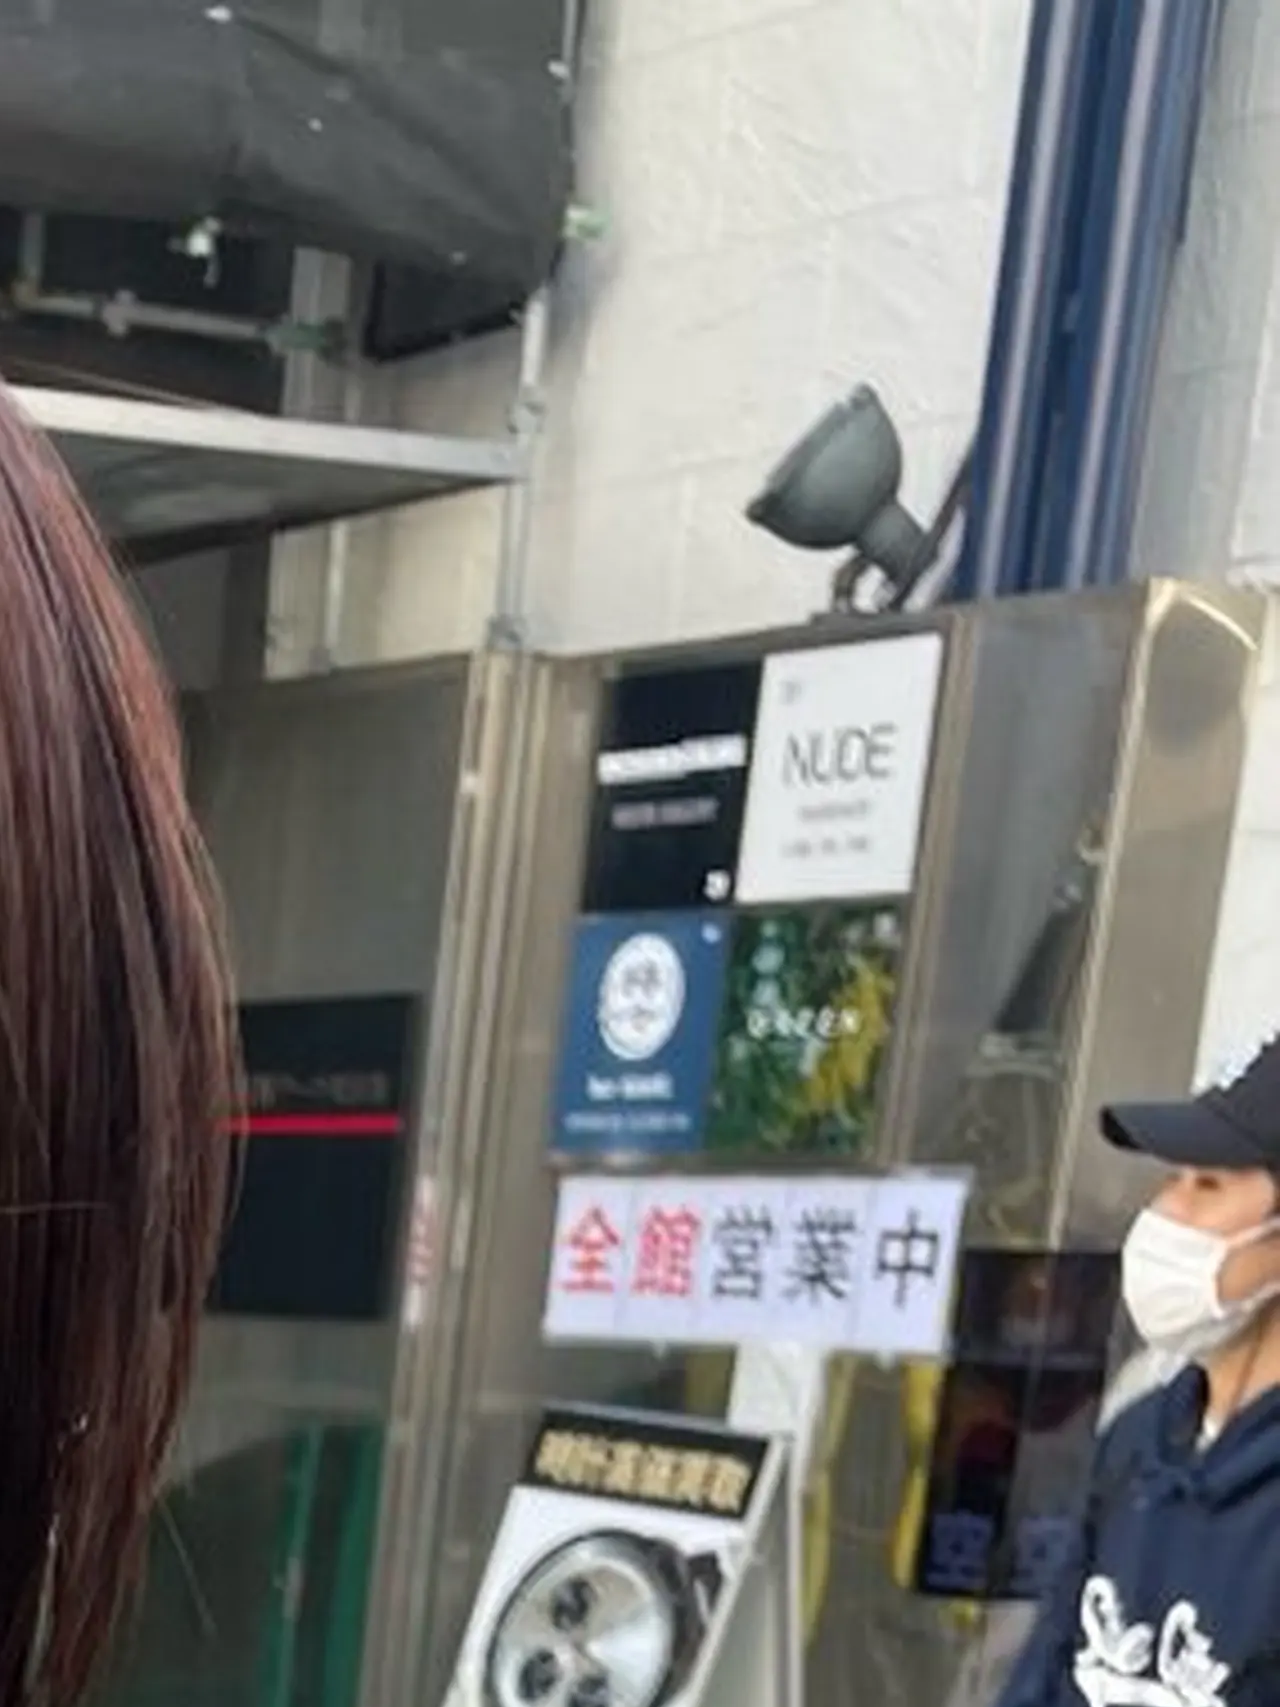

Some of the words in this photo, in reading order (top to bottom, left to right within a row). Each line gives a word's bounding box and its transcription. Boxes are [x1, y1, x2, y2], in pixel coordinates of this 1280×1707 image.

[782, 722, 897, 788] NUDE
[560, 1203, 940, 1308] 全館営業中
